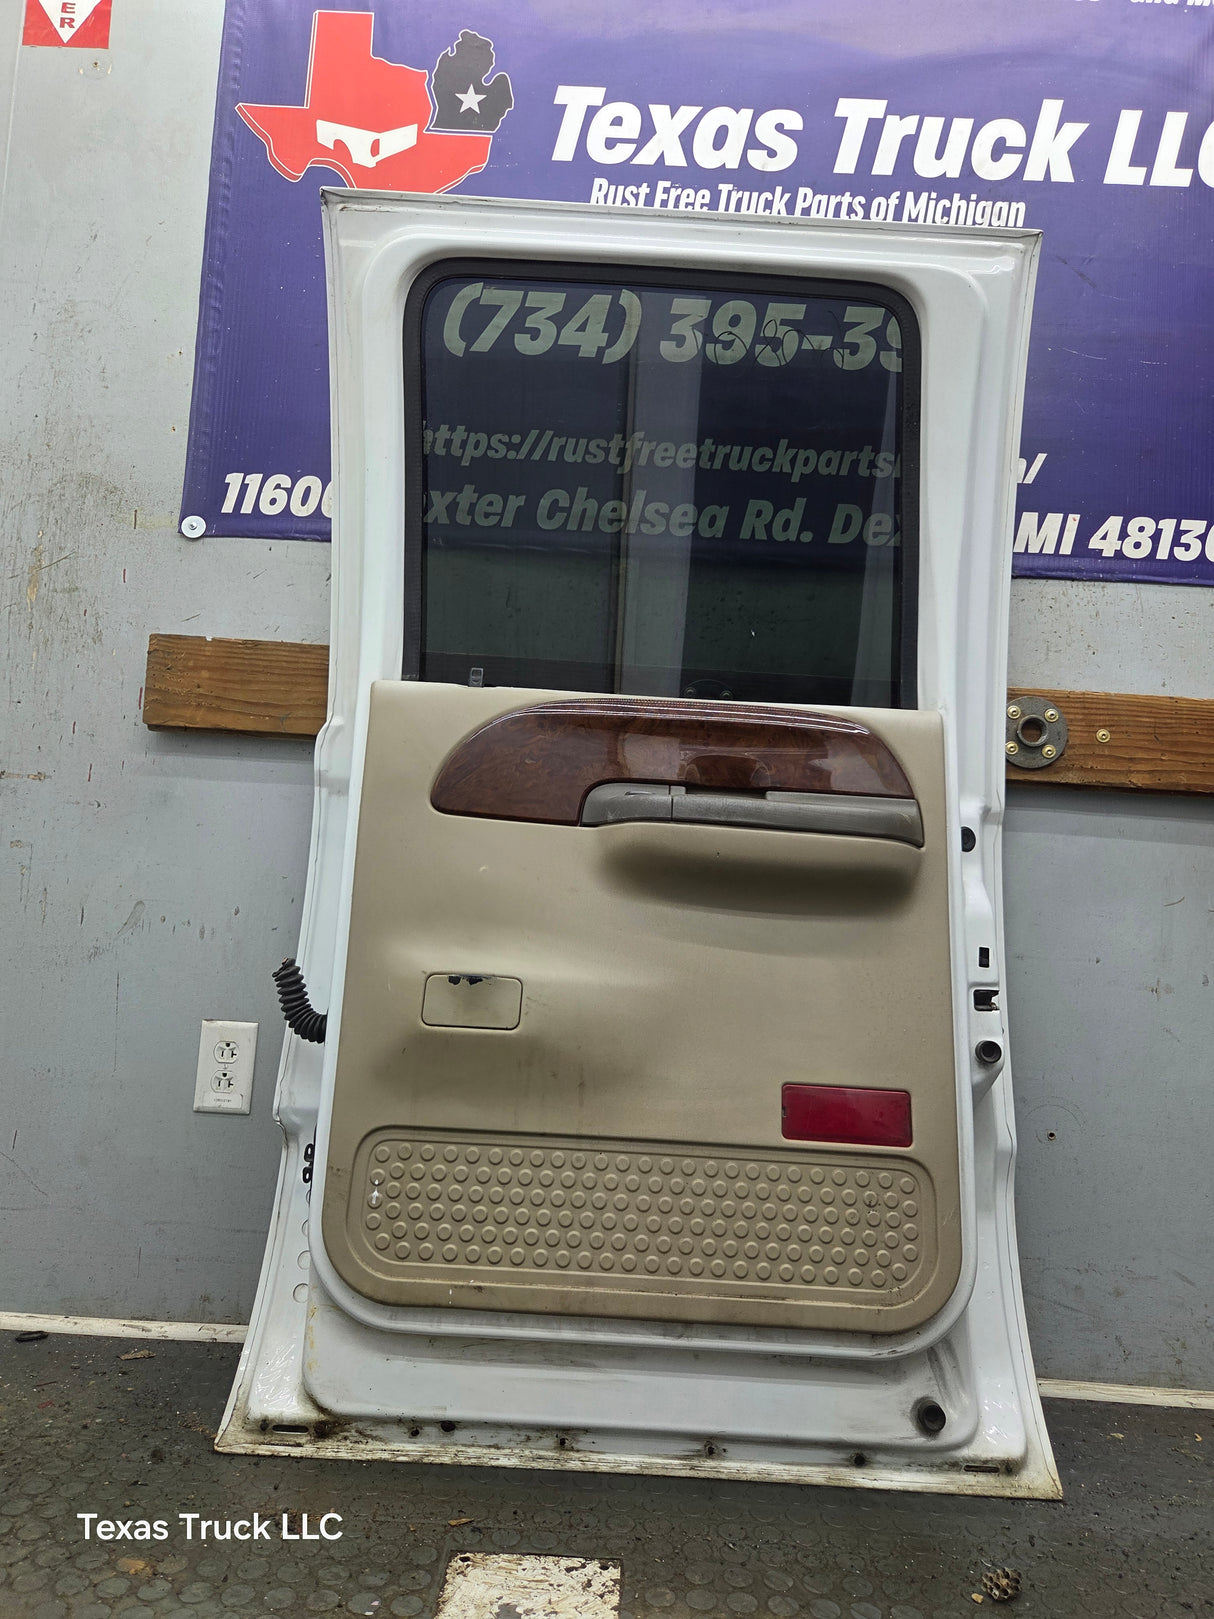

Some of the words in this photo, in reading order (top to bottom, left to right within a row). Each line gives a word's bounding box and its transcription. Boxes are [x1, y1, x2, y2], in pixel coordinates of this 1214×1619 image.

[551, 85, 804, 172] Texas
[833, 98, 1090, 182] Truck
[590, 177, 650, 207] Rust
[654, 180, 711, 212] Free
[717, 183, 791, 216] Truck
[794, 187, 866, 220] Parts
[870, 191, 900, 222] of
[902, 191, 1026, 228] Michigan
[443, 282, 642, 364] (734)
[536, 486, 729, 538] Chelsea
[739, 497, 814, 543] Rd.
[1013, 511, 1081, 555] MI
[1088, 515, 1214, 563] 4813
